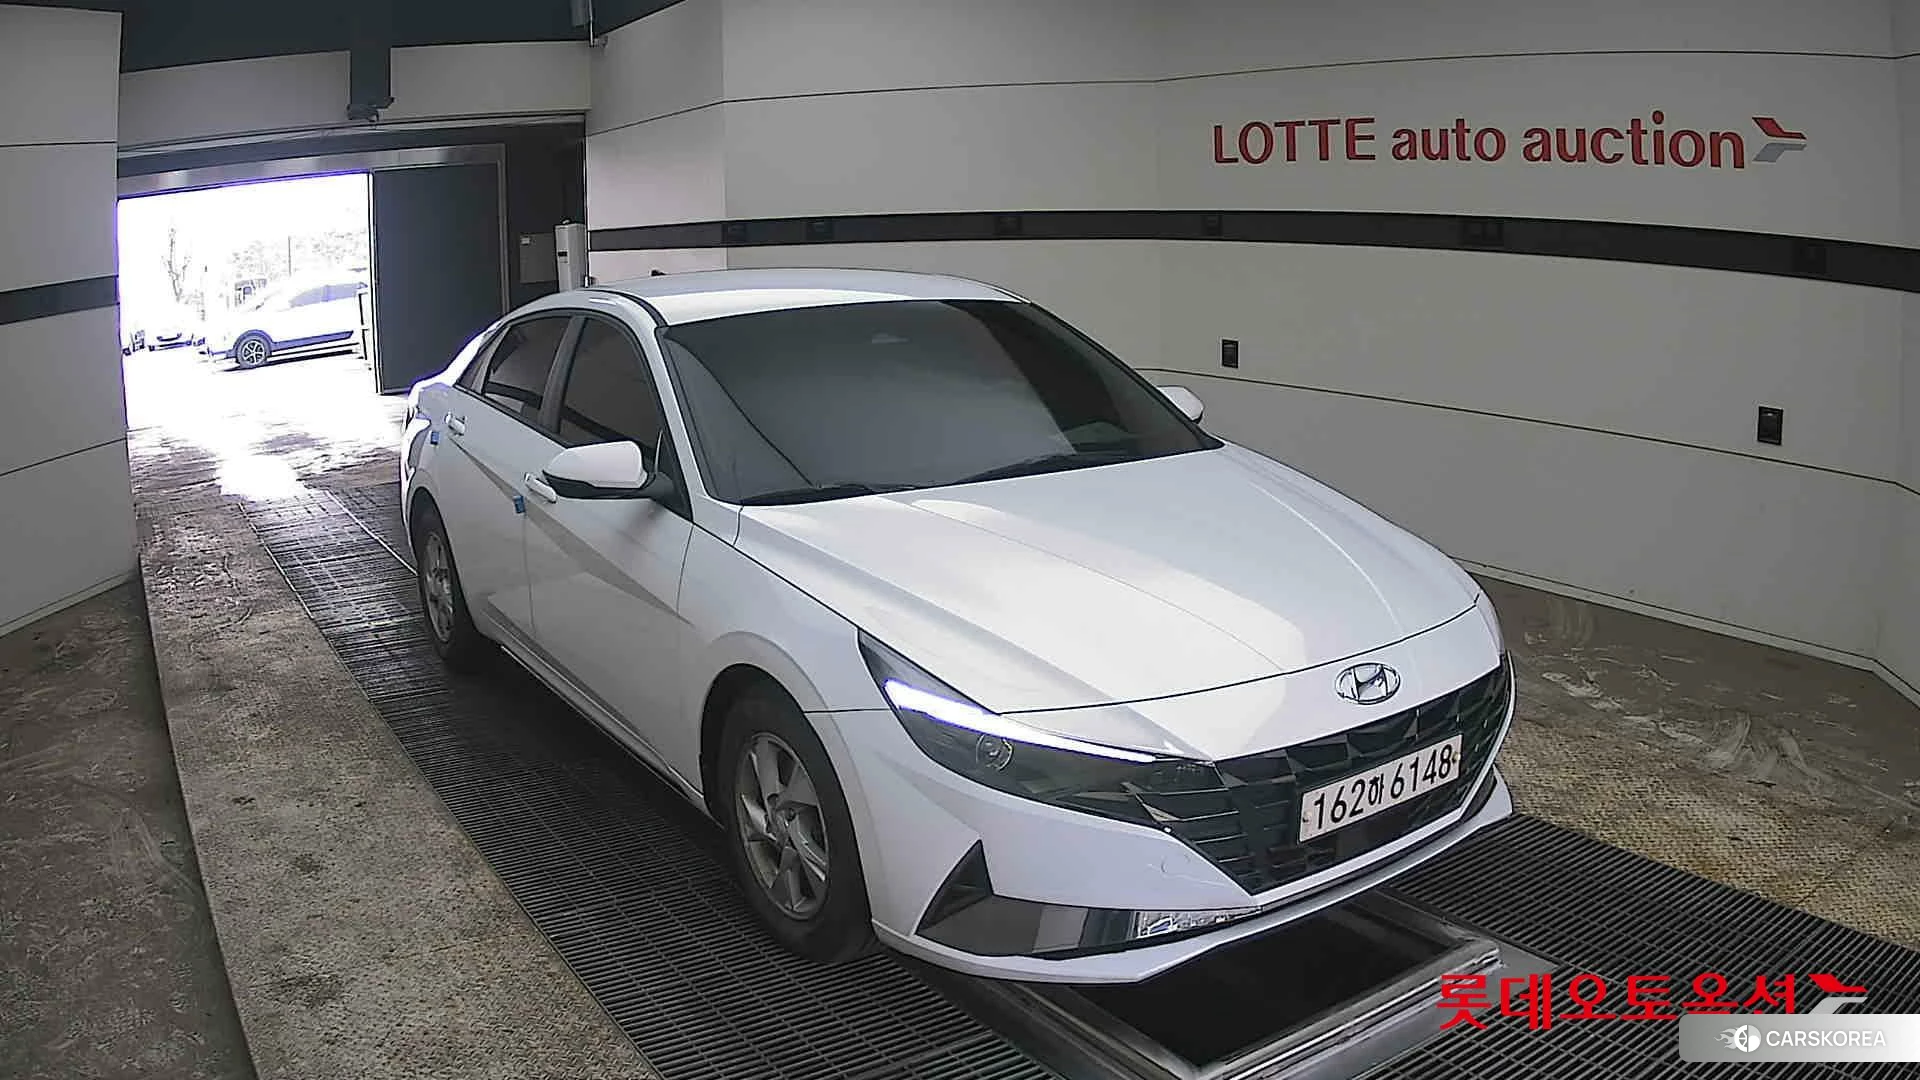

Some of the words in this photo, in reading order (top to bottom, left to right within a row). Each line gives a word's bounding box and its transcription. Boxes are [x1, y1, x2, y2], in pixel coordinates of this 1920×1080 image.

[1213, 117, 1376, 164] LOTTE
[1391, 117, 1506, 162] auto
[1522, 111, 1745, 169] auction
[1314, 773, 1384, 829] 162하
[1390, 744, 1452, 799] 6148
